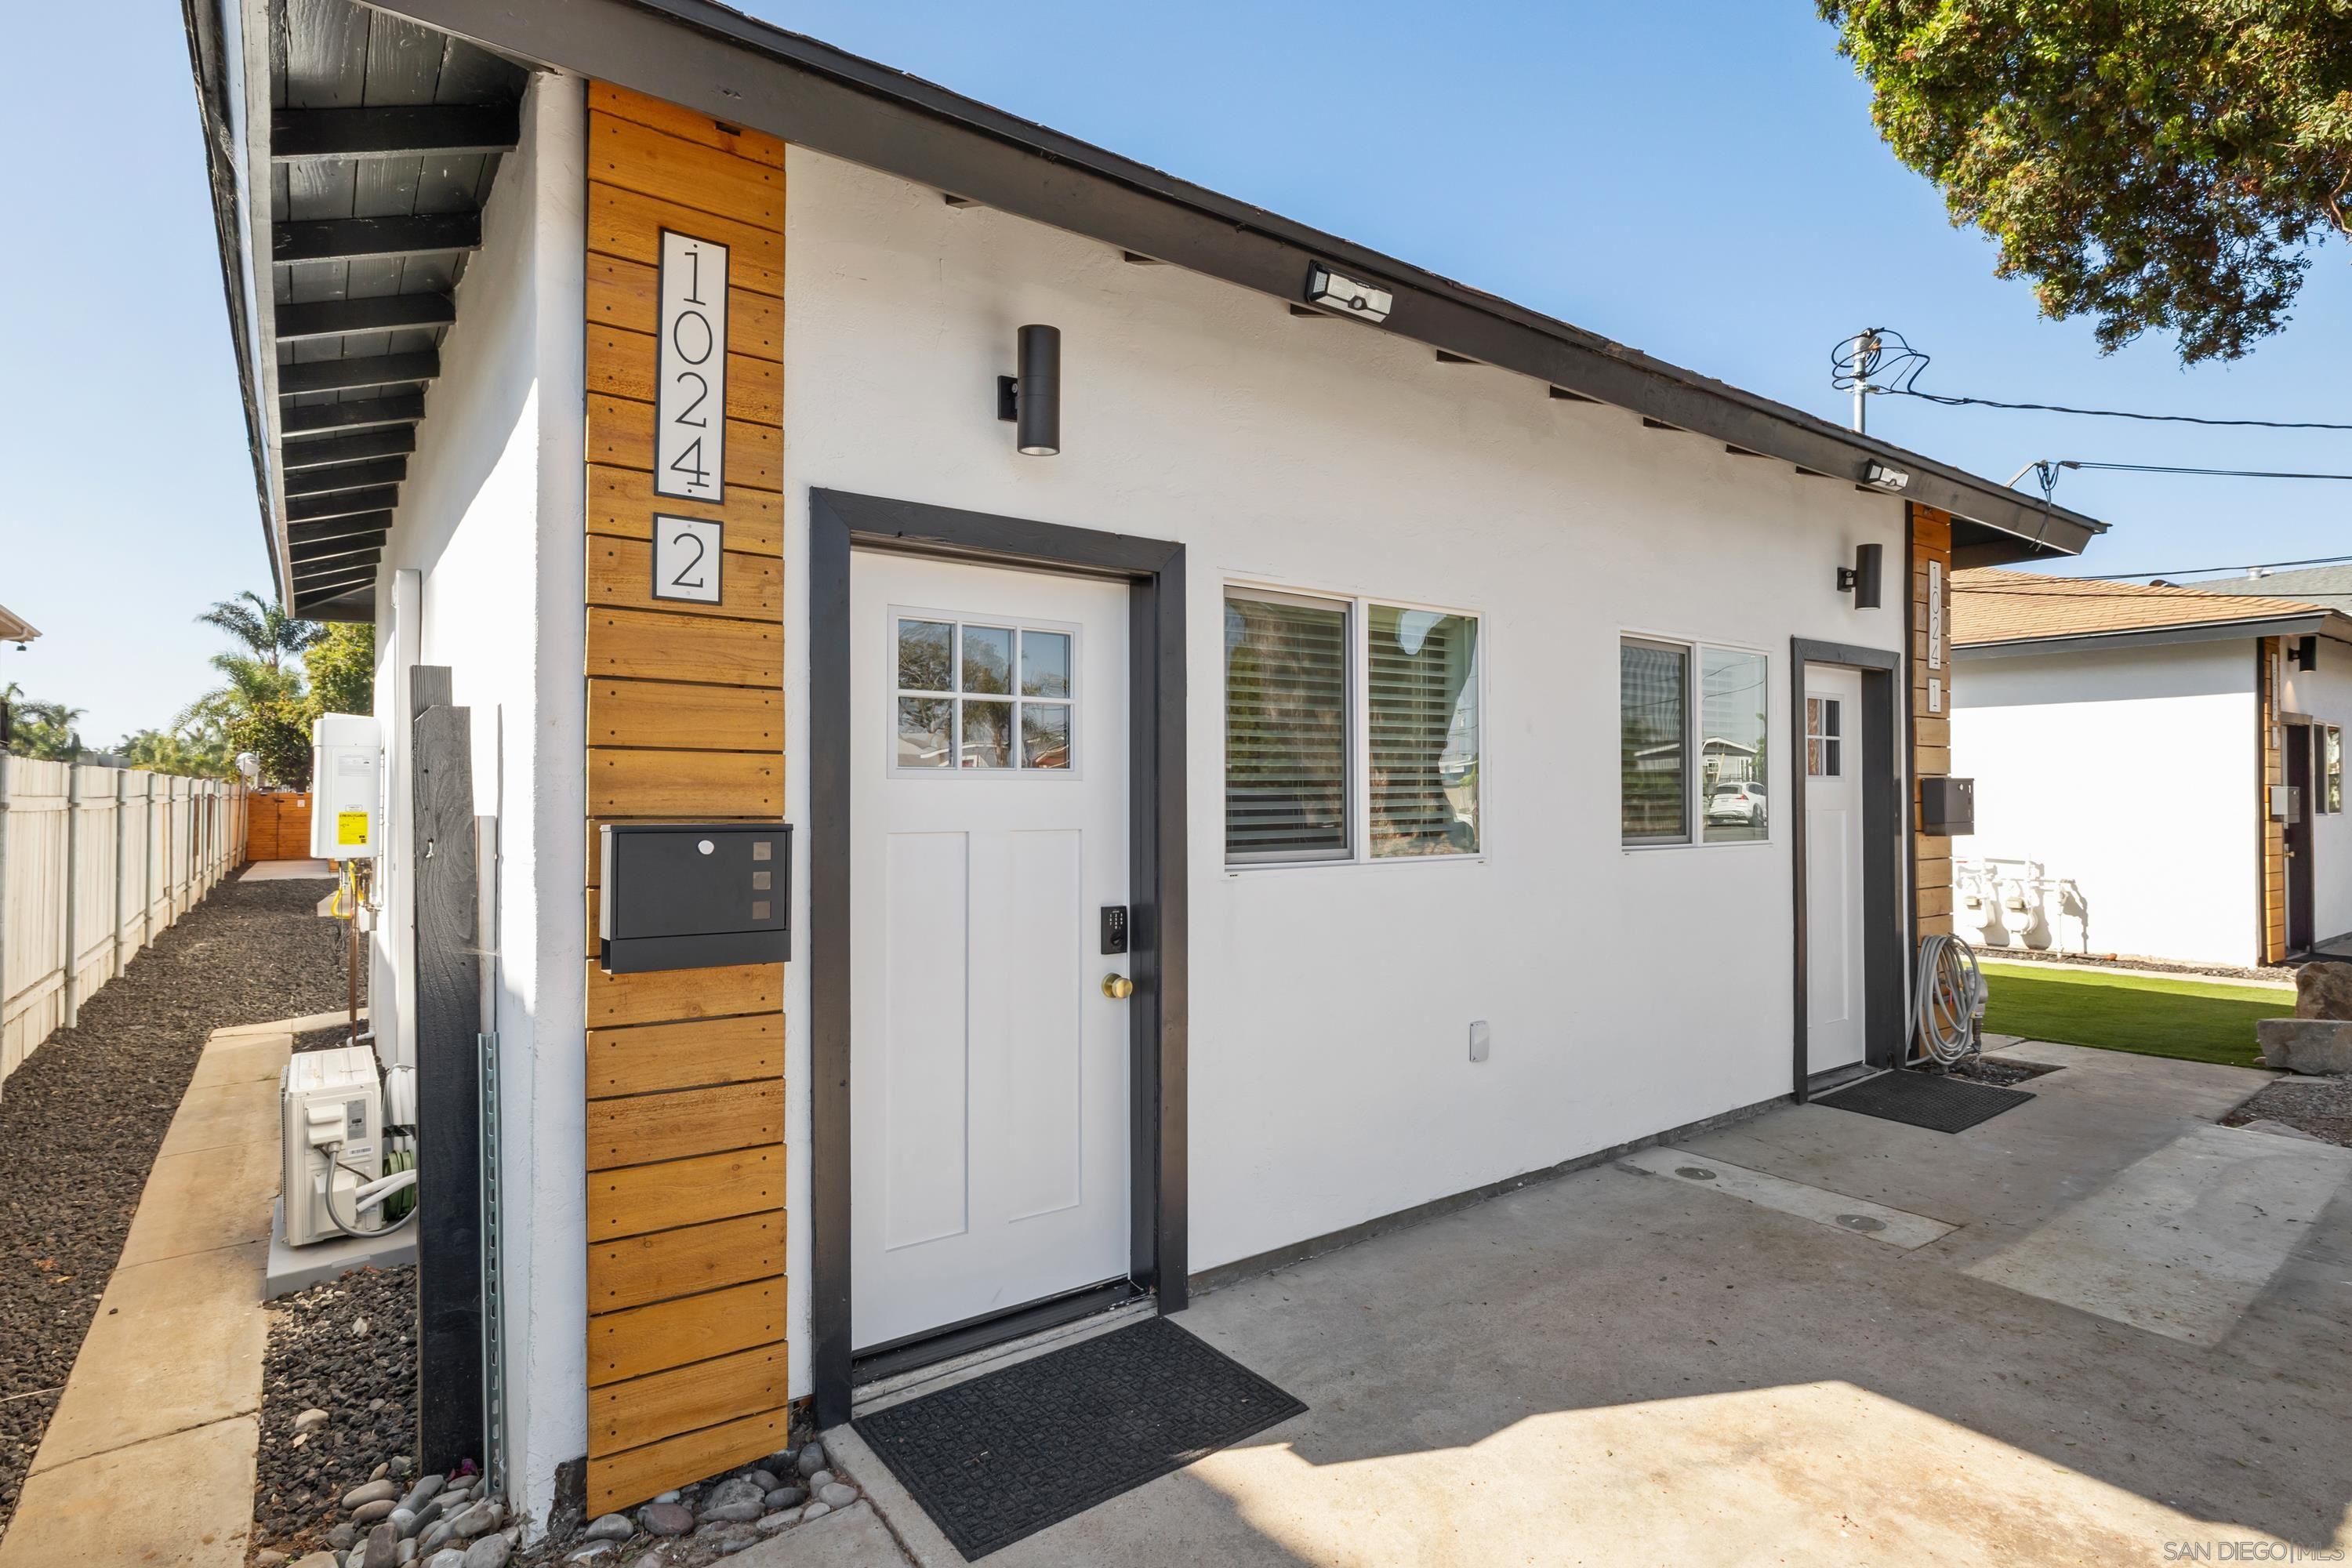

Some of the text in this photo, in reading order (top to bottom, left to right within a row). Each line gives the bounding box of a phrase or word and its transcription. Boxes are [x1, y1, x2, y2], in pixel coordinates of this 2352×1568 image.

[670, 252, 713, 488] 1024
[671, 533, 704, 587] 2
[1931, 566, 1940, 665] 1024
